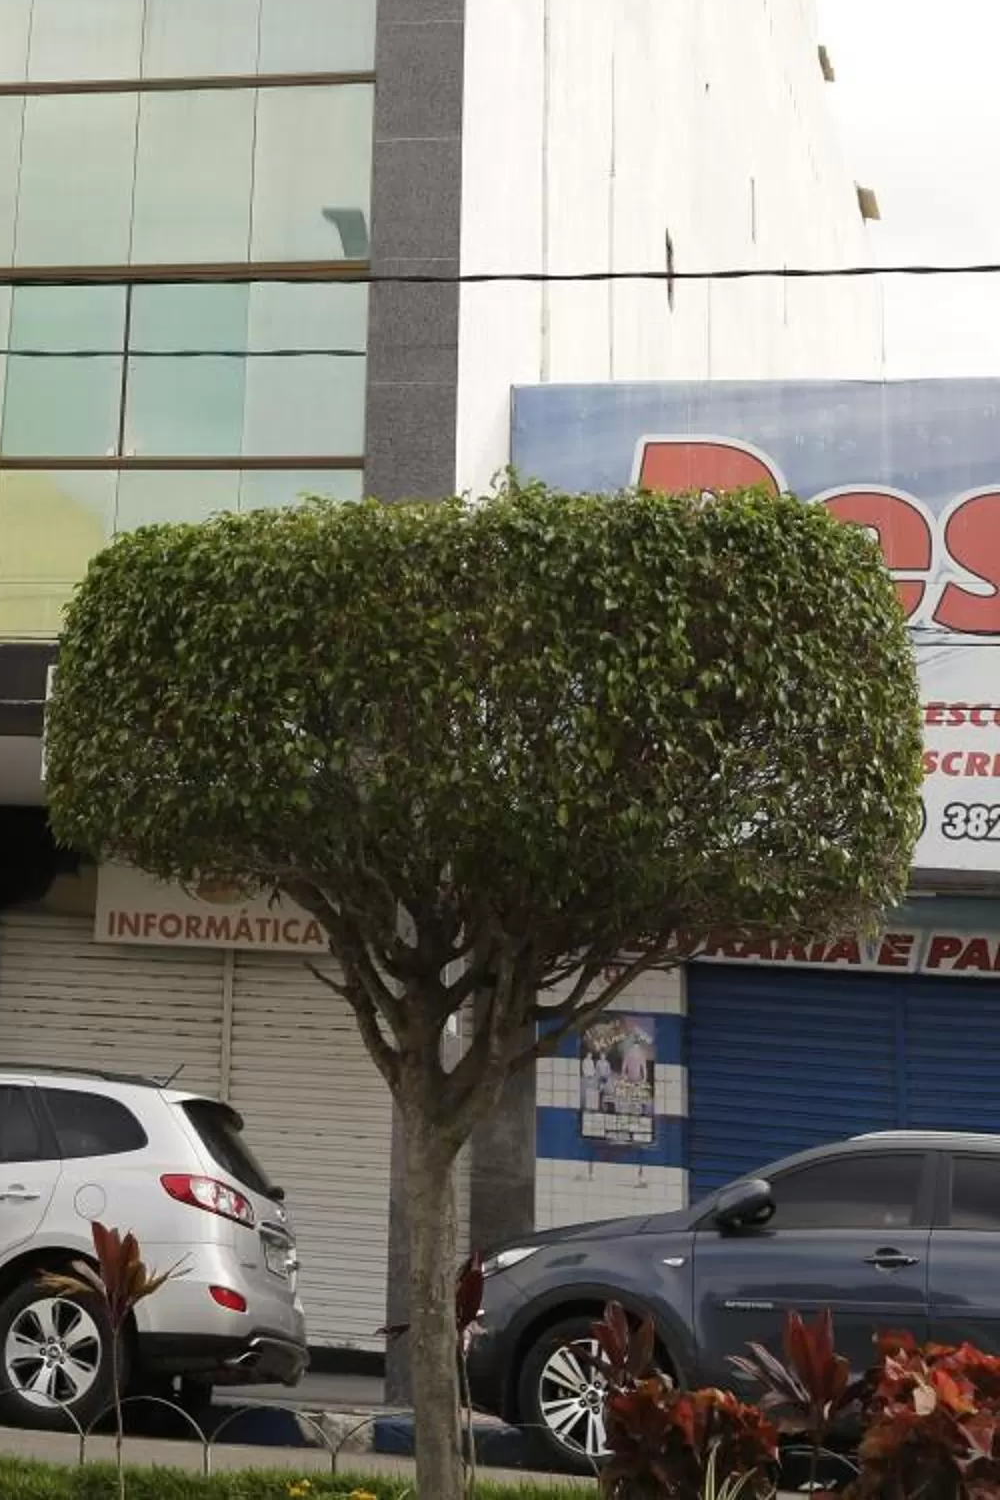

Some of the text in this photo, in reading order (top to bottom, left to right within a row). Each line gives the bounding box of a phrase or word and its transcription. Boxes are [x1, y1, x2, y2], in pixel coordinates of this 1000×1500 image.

[924, 701, 1000, 727] ESC
[107, 908, 323, 945] INFORMÁTICA
[878, 933, 915, 967] E
[926, 936, 1000, 971] PA
